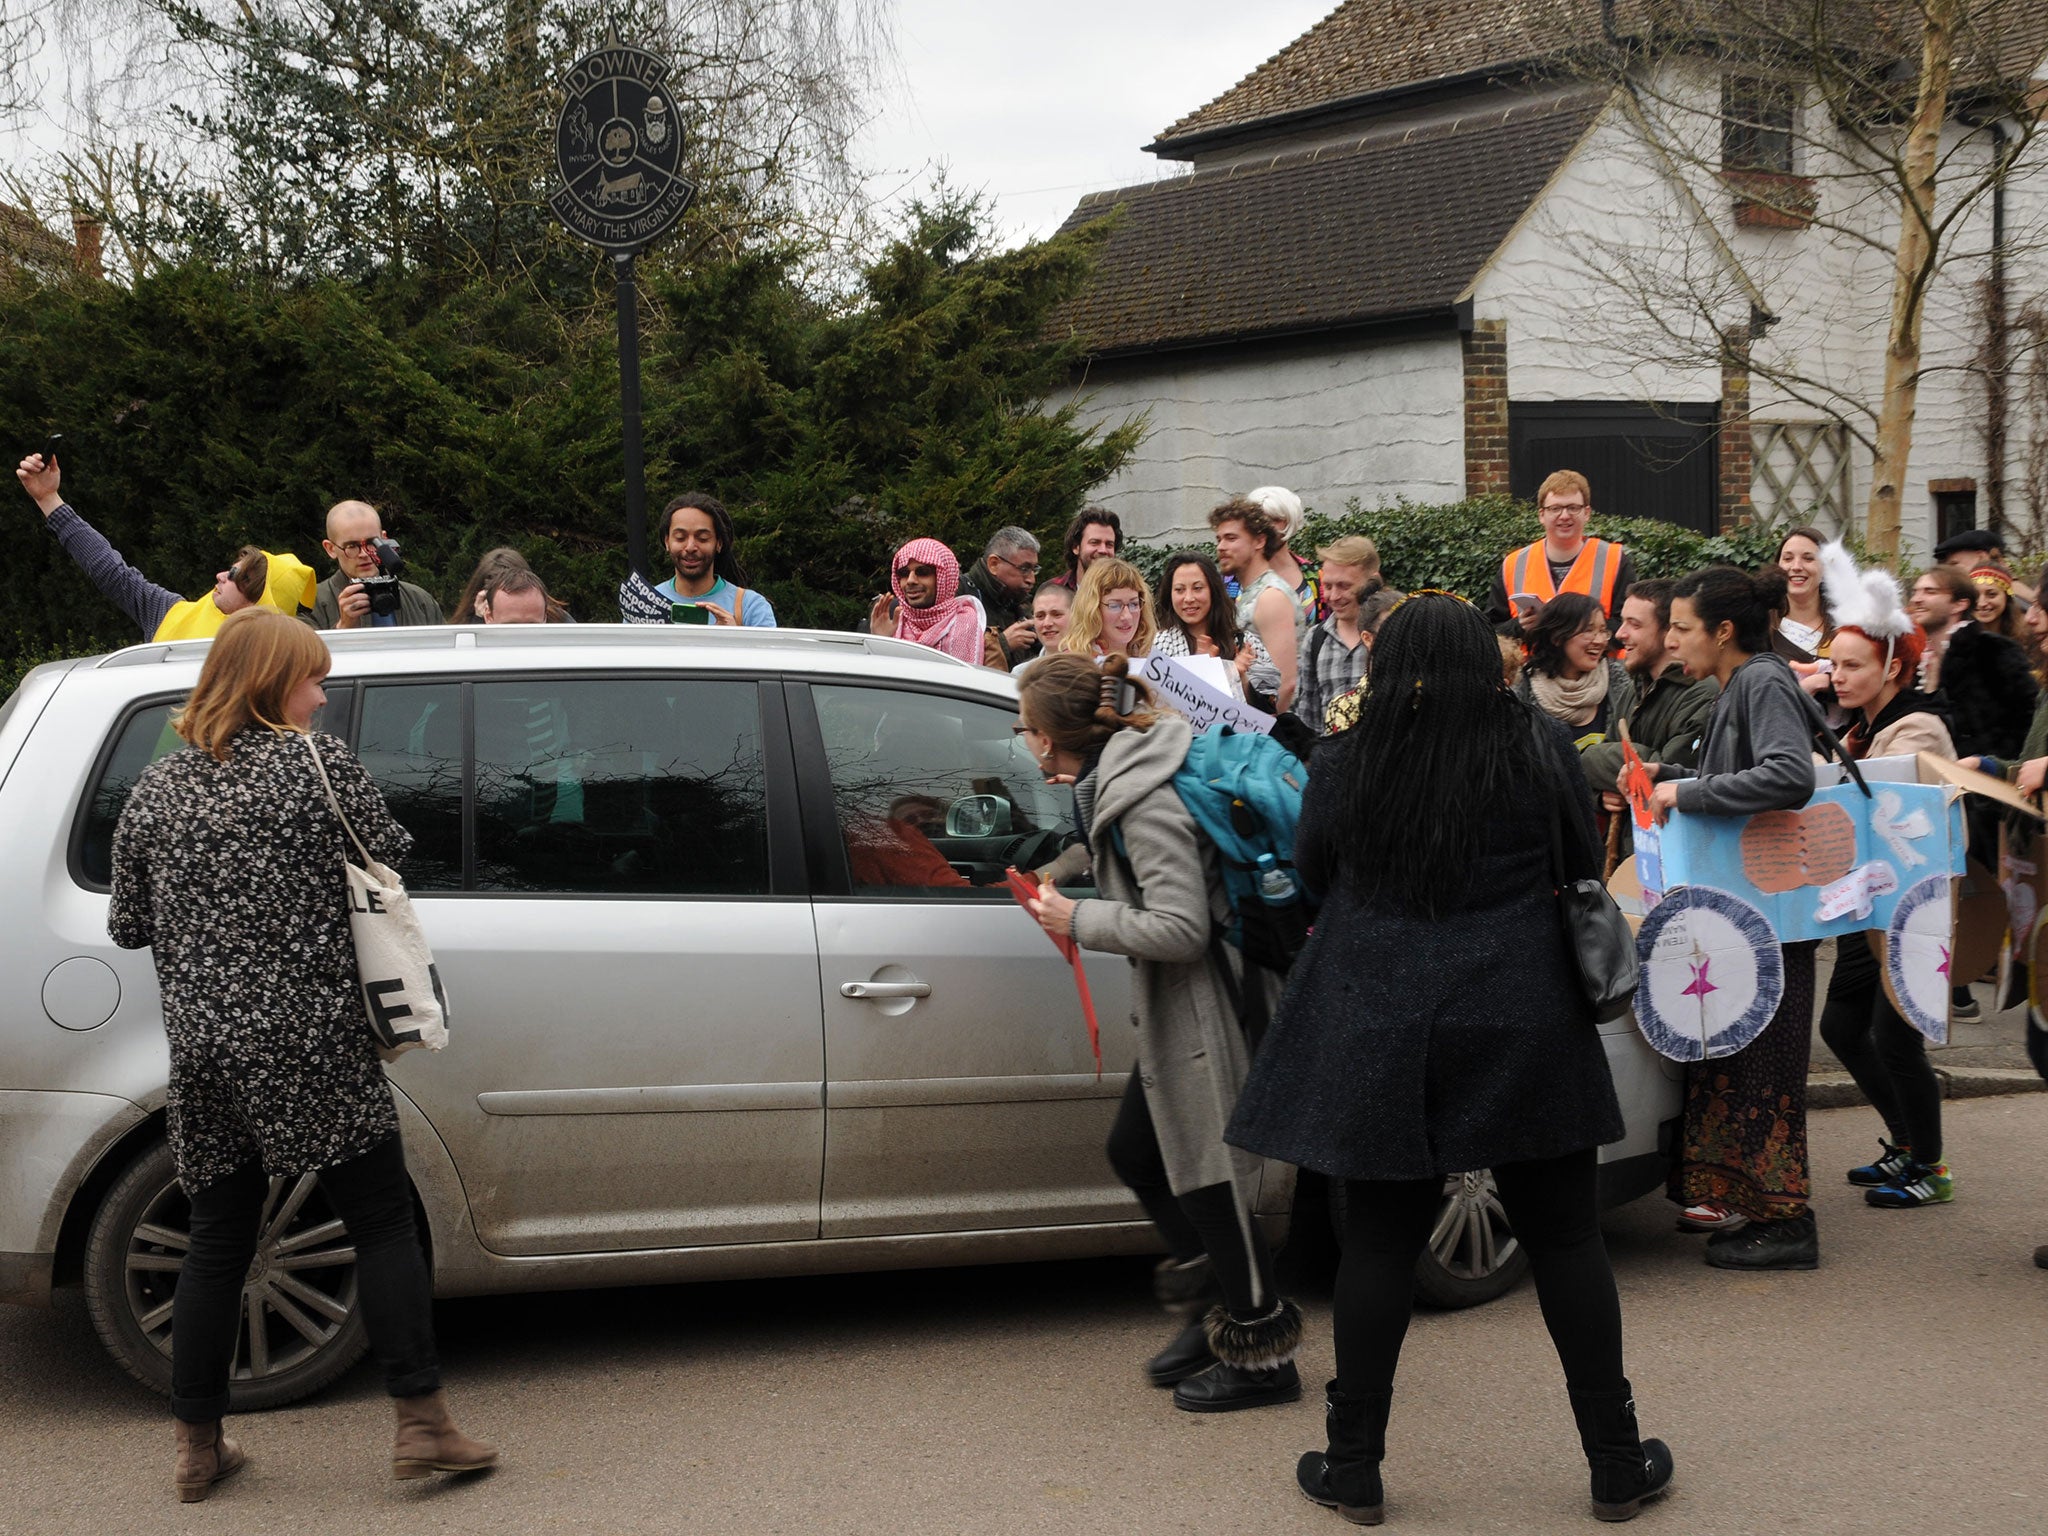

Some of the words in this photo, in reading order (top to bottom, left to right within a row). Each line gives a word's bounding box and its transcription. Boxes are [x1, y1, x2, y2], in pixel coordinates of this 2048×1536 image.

[569, 51, 659, 93] DOWNE
[568, 154, 596, 163] INVICTA
[557, 193, 574, 212] ST
[568, 206, 601, 235] MARY
[603, 222, 627, 239] THE
[629, 203, 669, 236] VIRGIN
[620, 583, 662, 615] Exposin
[630, 571, 672, 611] Exposin
[348, 885, 387, 914] LE
